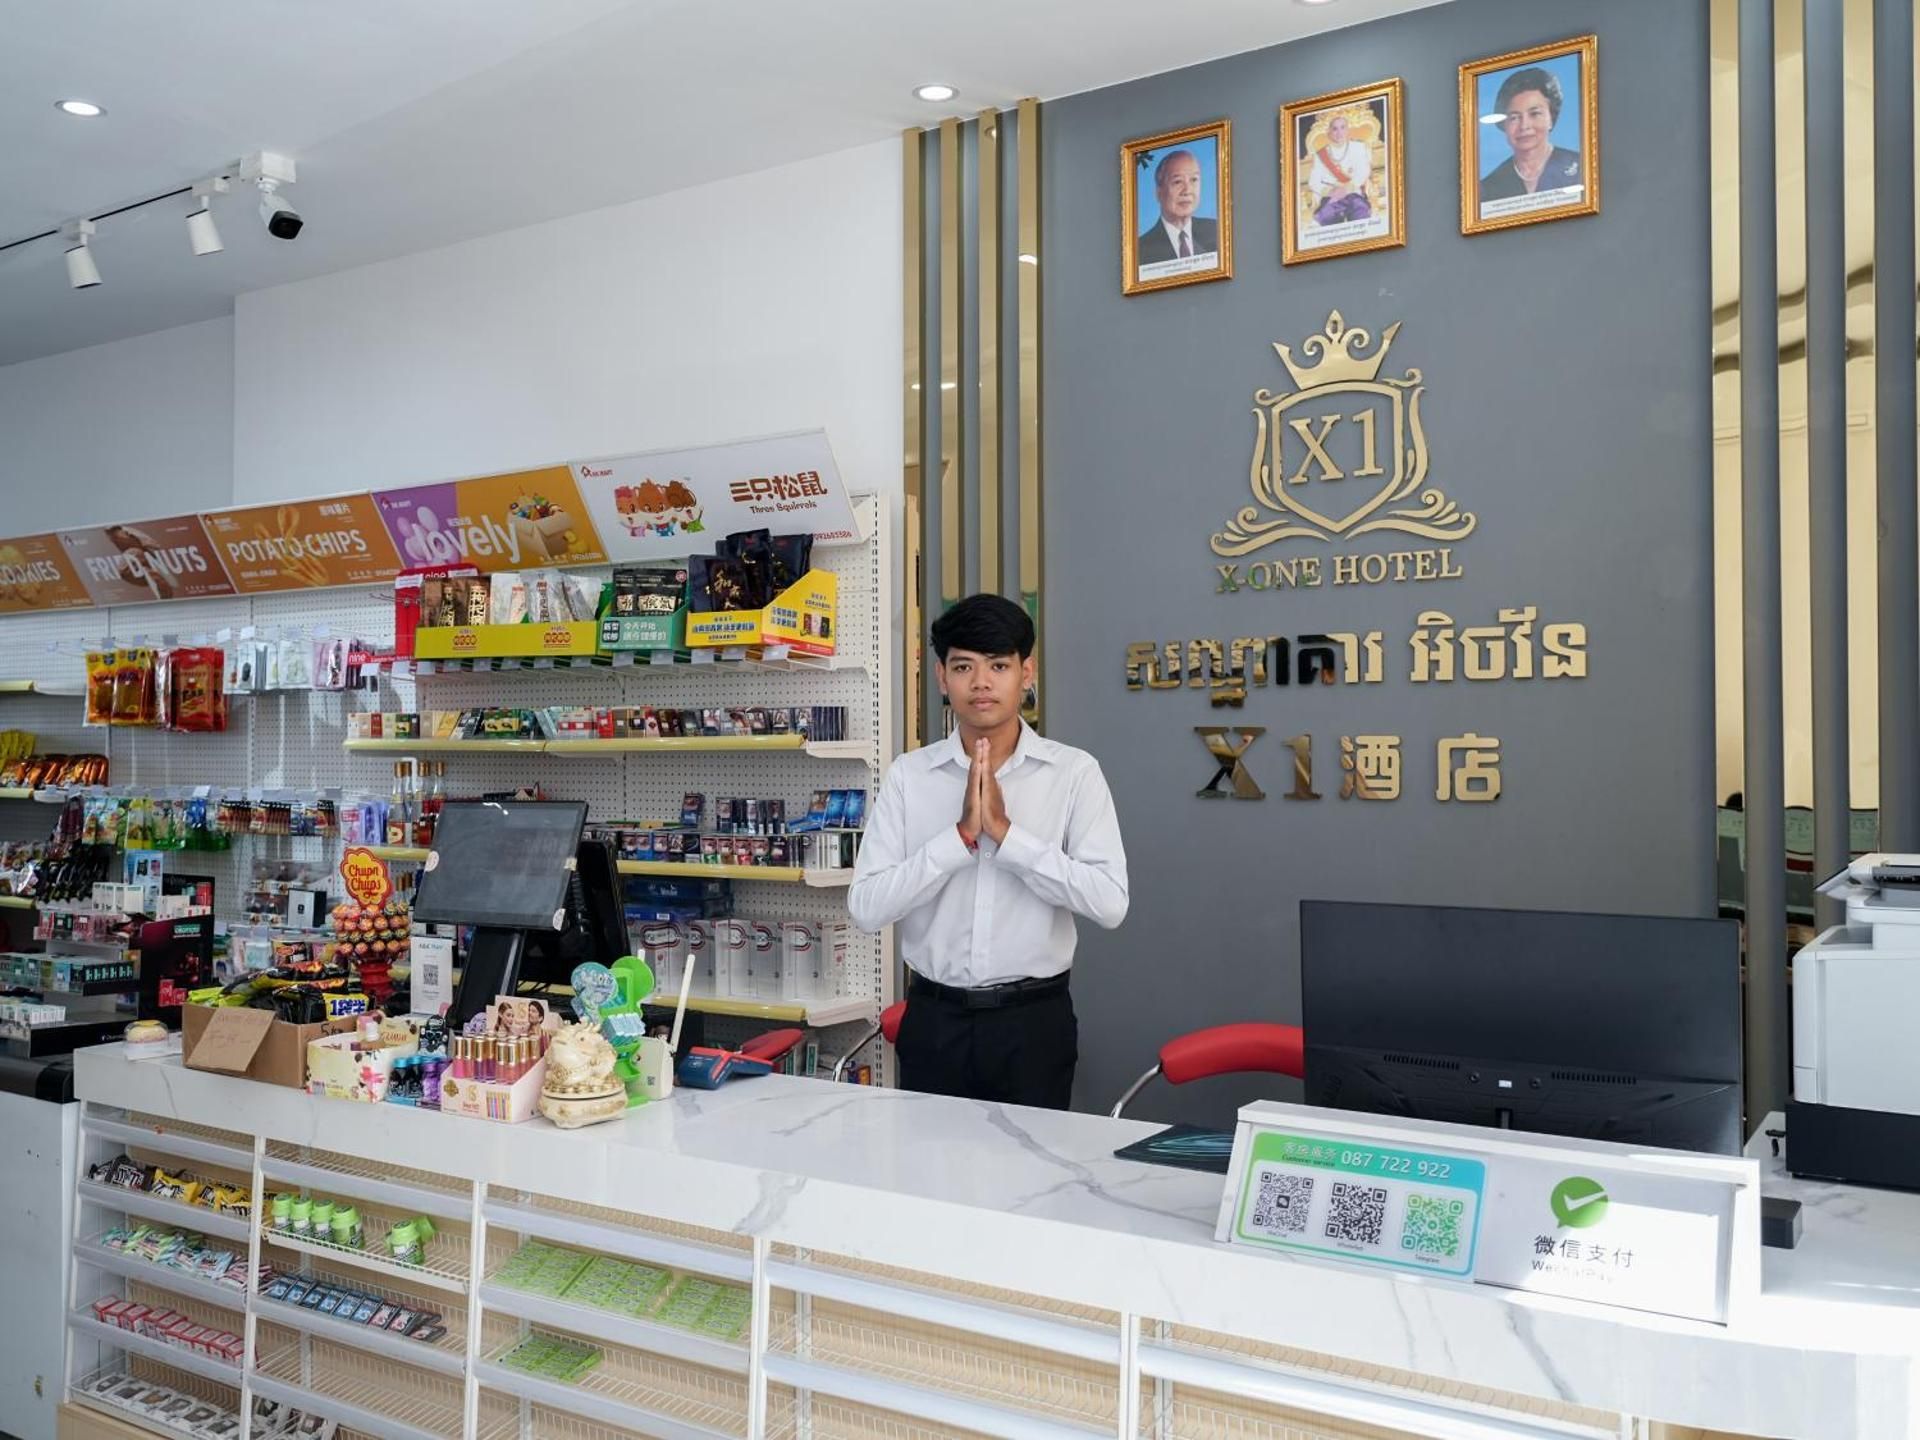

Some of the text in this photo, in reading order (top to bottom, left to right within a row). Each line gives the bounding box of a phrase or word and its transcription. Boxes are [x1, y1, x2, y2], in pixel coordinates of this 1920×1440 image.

[1289, 408, 1384, 484] X1
[729, 471, 827, 502] 三只松鼠
[749, 500, 817, 514] Three Squirrels
[227, 529, 367, 563] POTATO CHIPS
[411, 514, 520, 564] lovely
[145, 545, 208, 575] NUTS
[1215, 548, 1464, 594] X-ONE HOTEL
[1126, 630, 1384, 709] សណ្ឋាគារ
[1194, 726, 1501, 802] X1 酒店
[348, 864, 379, 880] Chupa
[351, 878, 381, 895] Chups
[1341, 1150, 1452, 1179] 087 722 922
[1533, 1233, 1635, 1269] 微信支付
